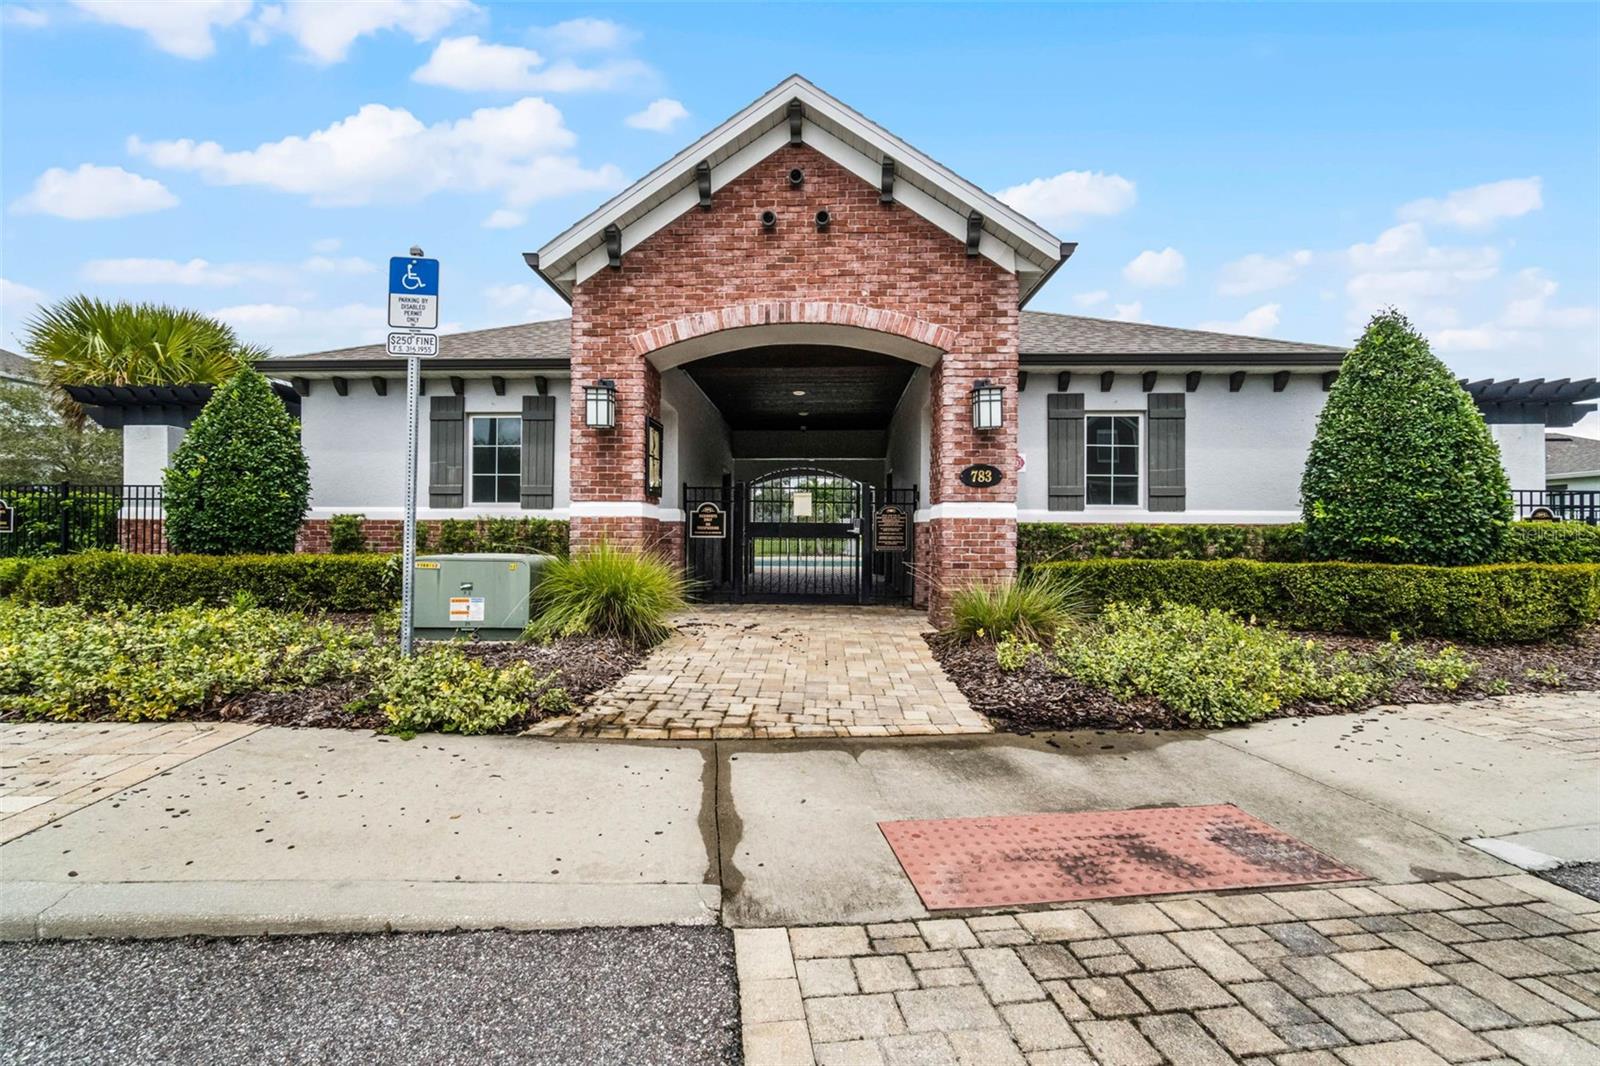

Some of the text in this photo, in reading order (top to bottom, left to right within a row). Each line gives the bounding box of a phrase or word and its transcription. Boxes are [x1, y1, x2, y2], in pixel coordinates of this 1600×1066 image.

[390, 335, 435, 346] $250 FINE
[970, 469, 993, 483] 783
